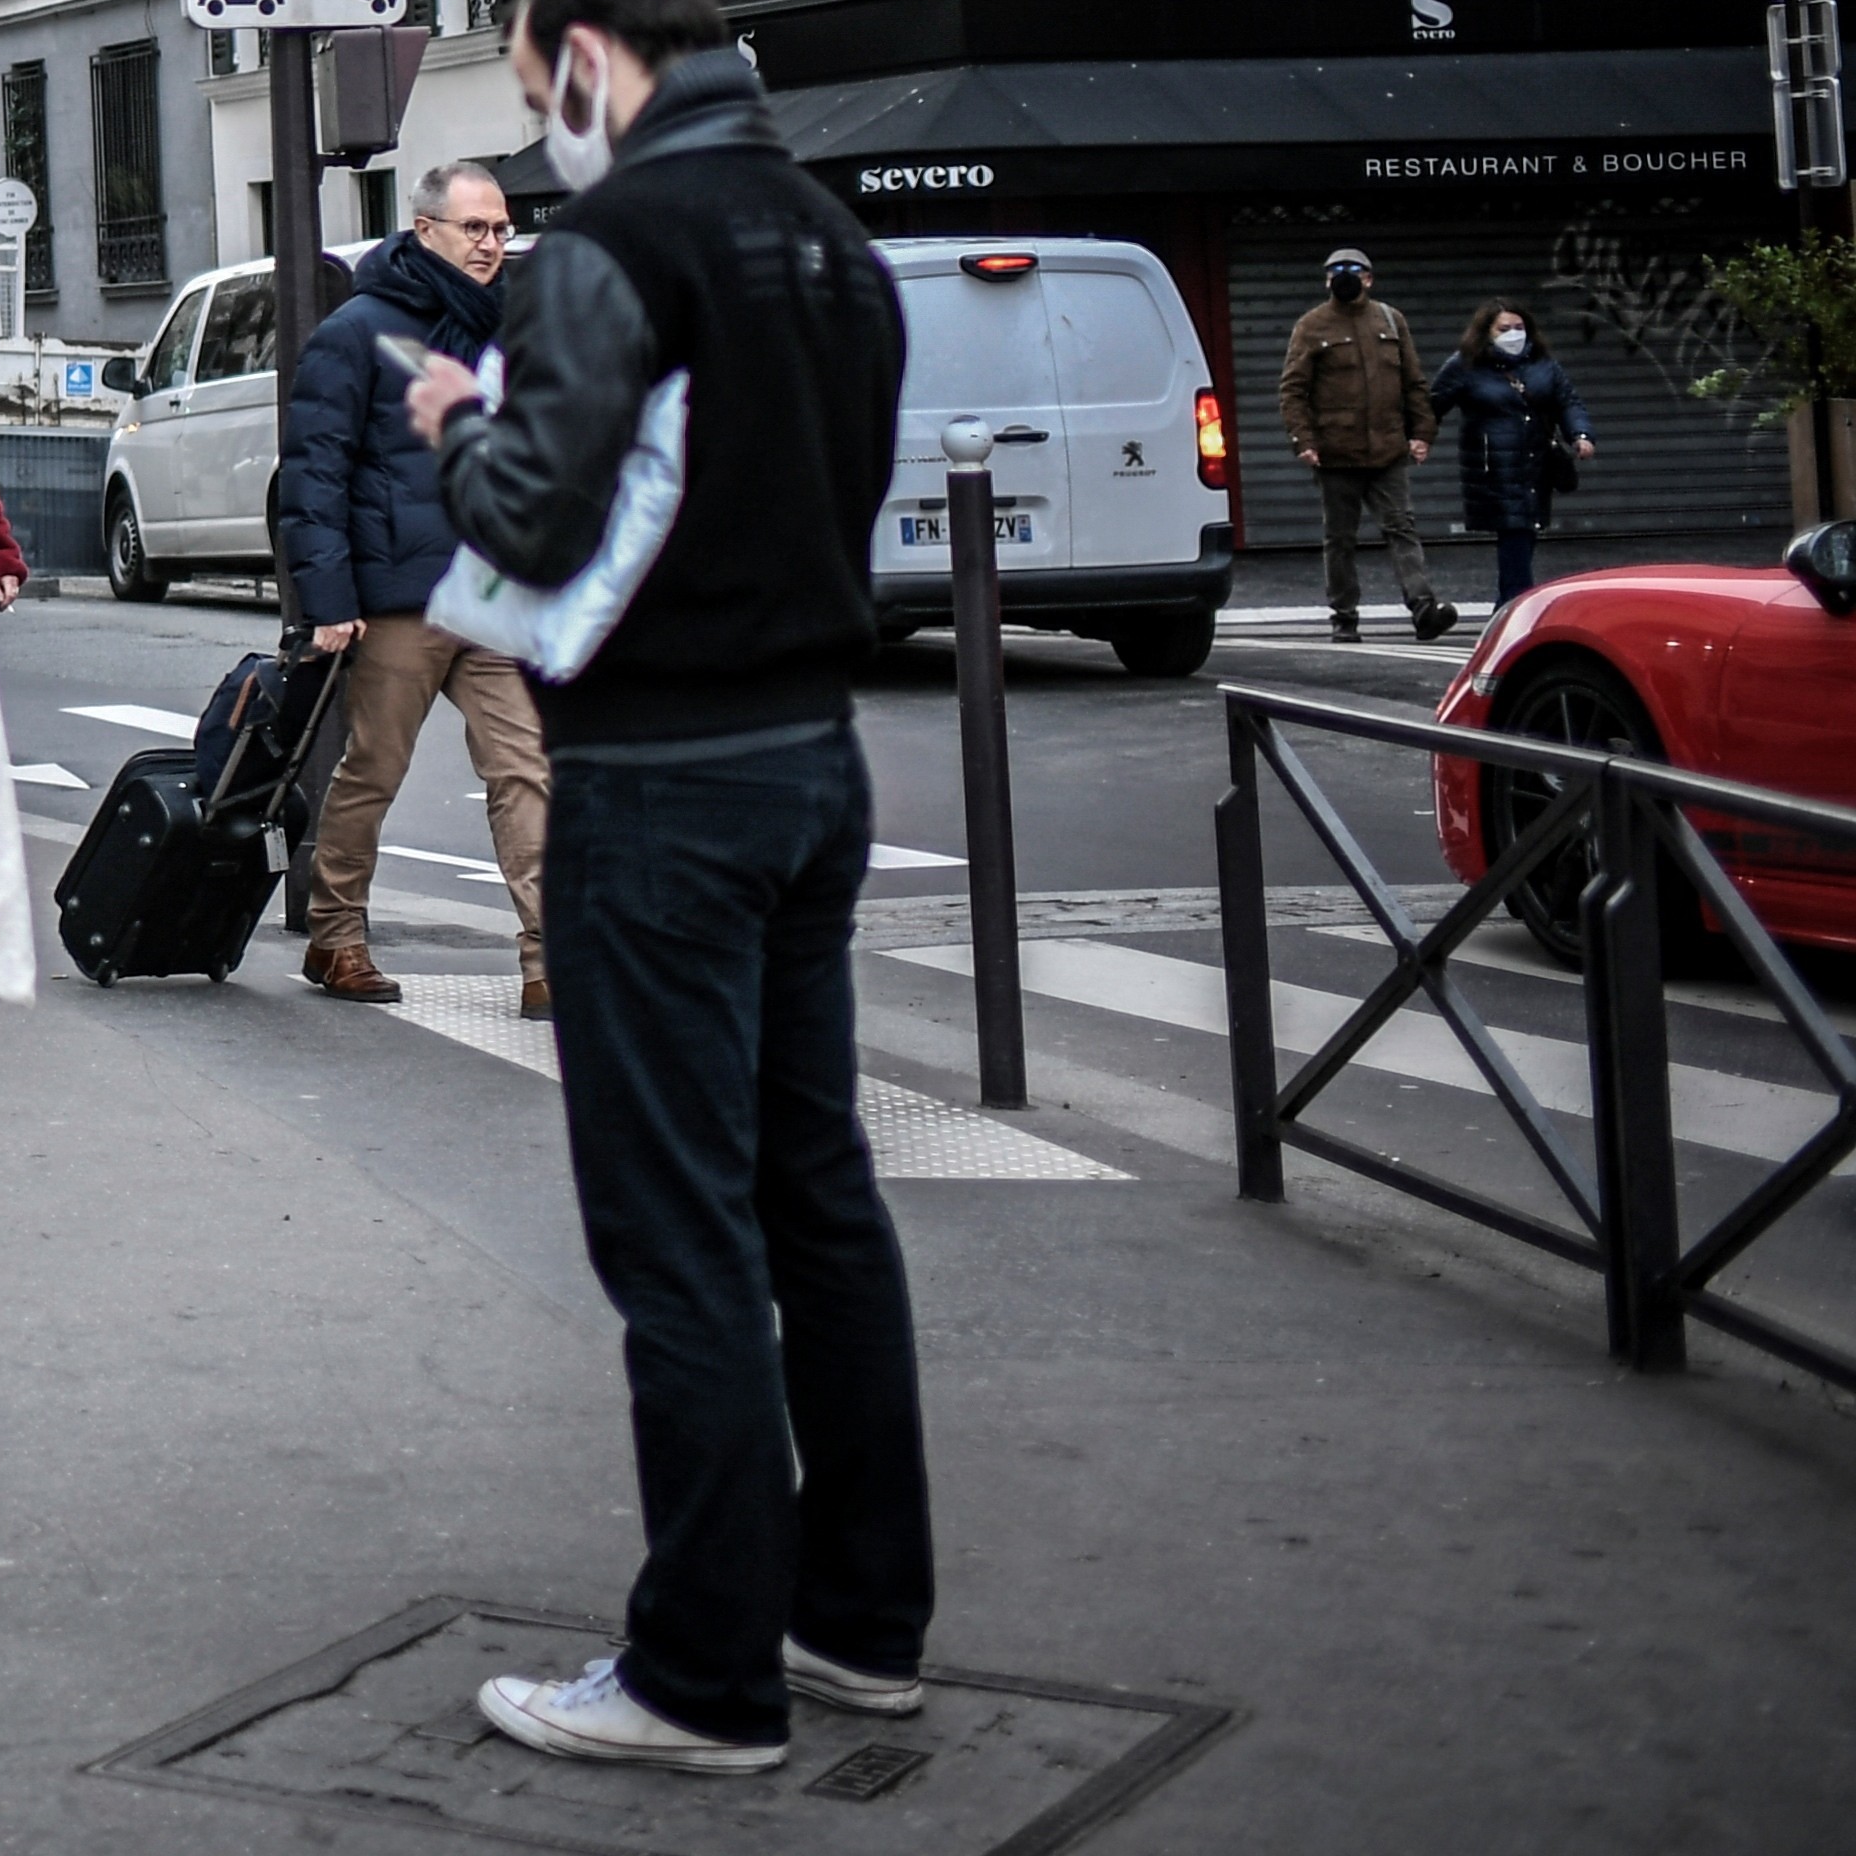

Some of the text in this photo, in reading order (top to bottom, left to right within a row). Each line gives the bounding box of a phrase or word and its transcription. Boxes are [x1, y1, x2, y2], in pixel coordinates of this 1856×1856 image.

[860, 164, 995, 193] severo
[1365, 151, 1747, 178] RESTAURANT & BOUCHER
